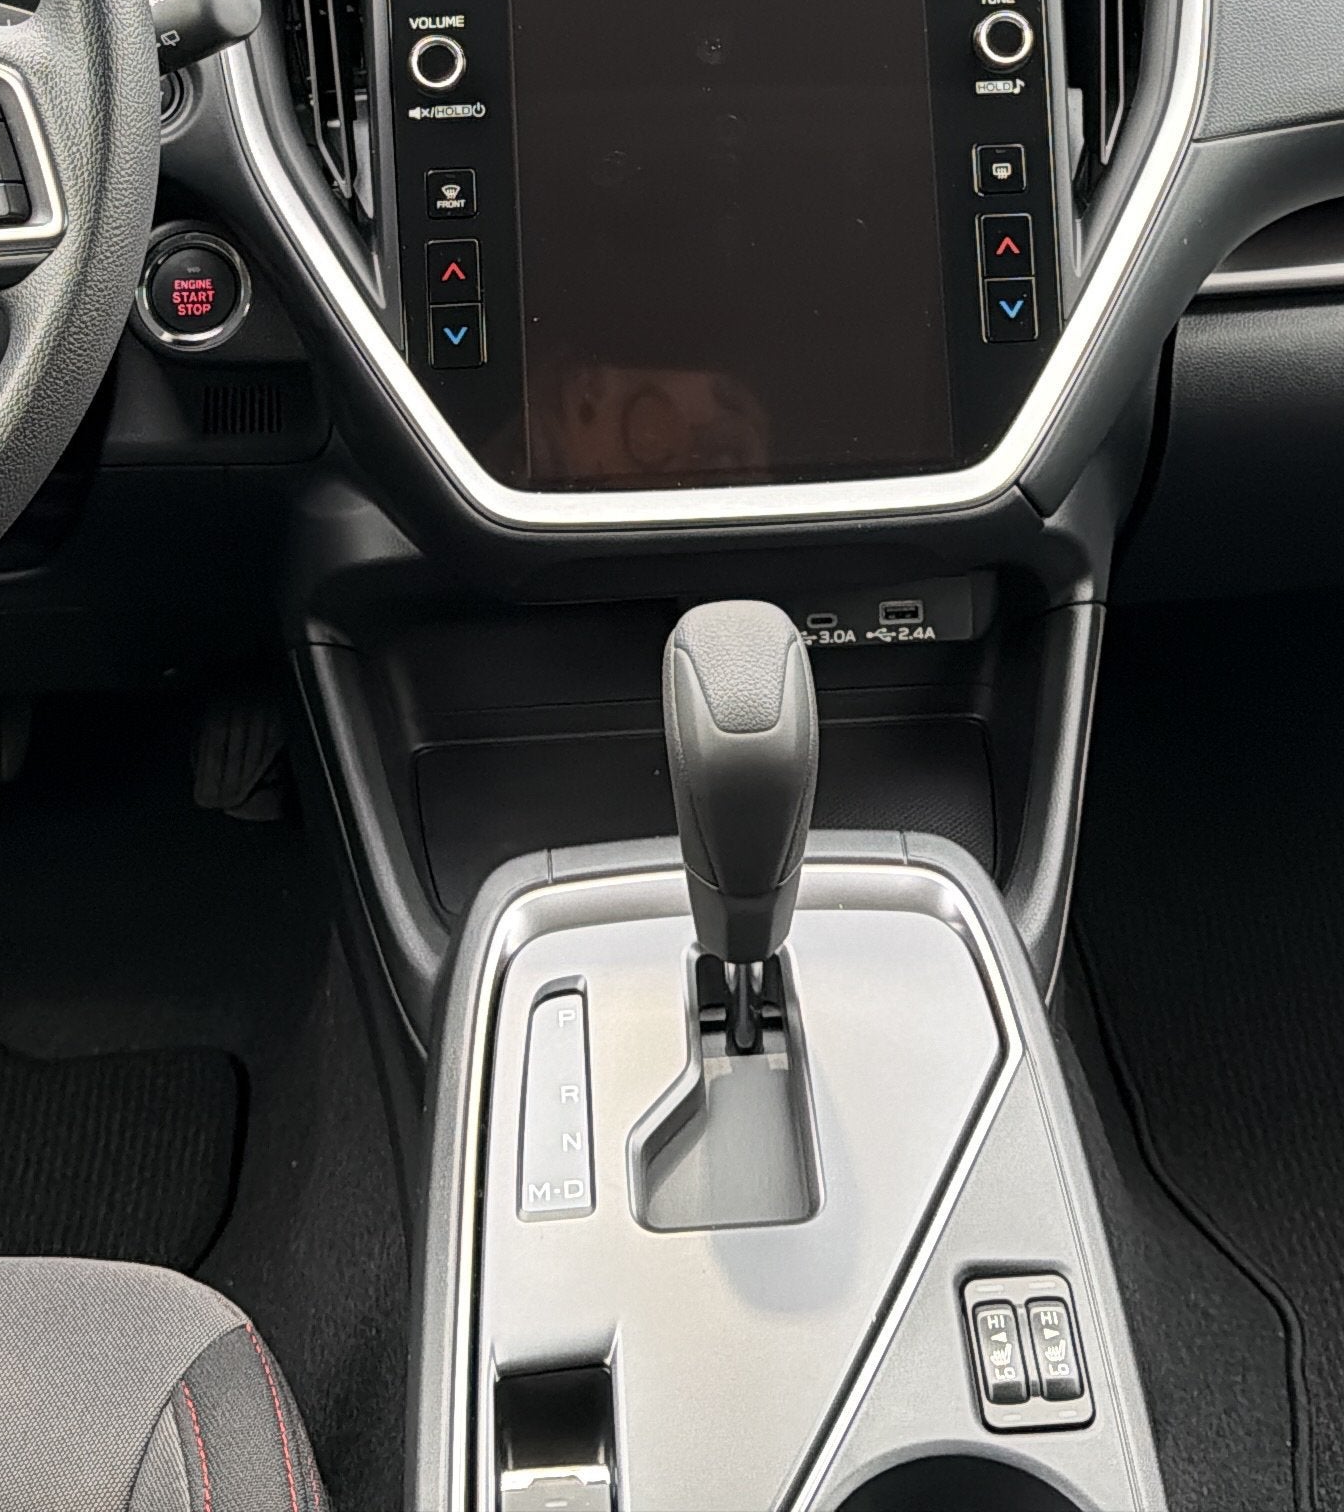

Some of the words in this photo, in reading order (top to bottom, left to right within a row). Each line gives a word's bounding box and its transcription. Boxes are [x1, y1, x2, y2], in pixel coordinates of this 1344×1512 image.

[408, 15, 465, 29] VOLUME
[977, 81, 1011, 93] HOLD
[436, 105, 471, 117] HOLD
[436, 199, 466, 209] FRONT
[174, 278, 212, 290] ENGINE
[172, 290, 215, 303] START
[177, 303, 212, 316] STOP
[819, 629, 856, 644] 3.0A
[898, 627, 936, 641] 2.4A
[558, 1009, 577, 1028] P
[559, 1084, 580, 1104] R
[562, 1132, 582, 1152] N
[987, 1314, 1006, 1330] HI
[1040, 1311, 1059, 1326] HI
[994, 1367, 1016, 1380] LO
[1048, 1363, 1070, 1376] LO
